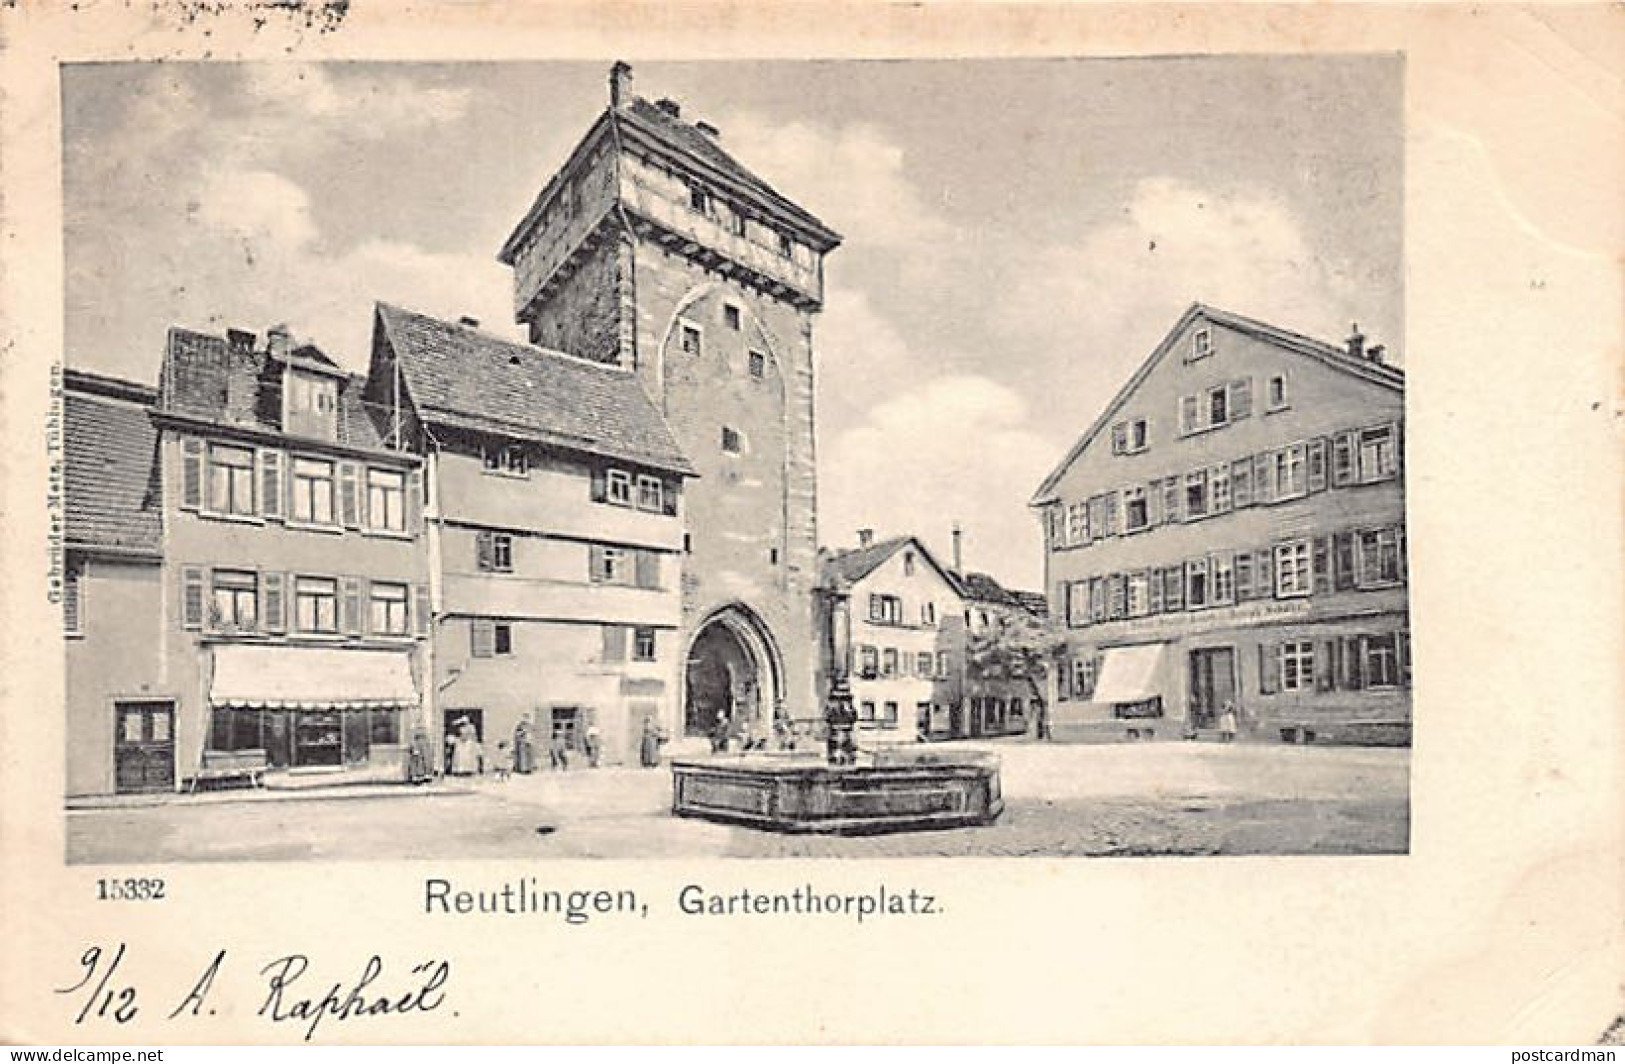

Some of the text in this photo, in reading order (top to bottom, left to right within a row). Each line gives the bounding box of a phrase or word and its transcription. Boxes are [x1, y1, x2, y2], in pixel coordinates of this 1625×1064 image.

[97, 878, 165, 901] 15332
[425, 877, 944, 924] Reutlingen, Gartenthorplatz.
